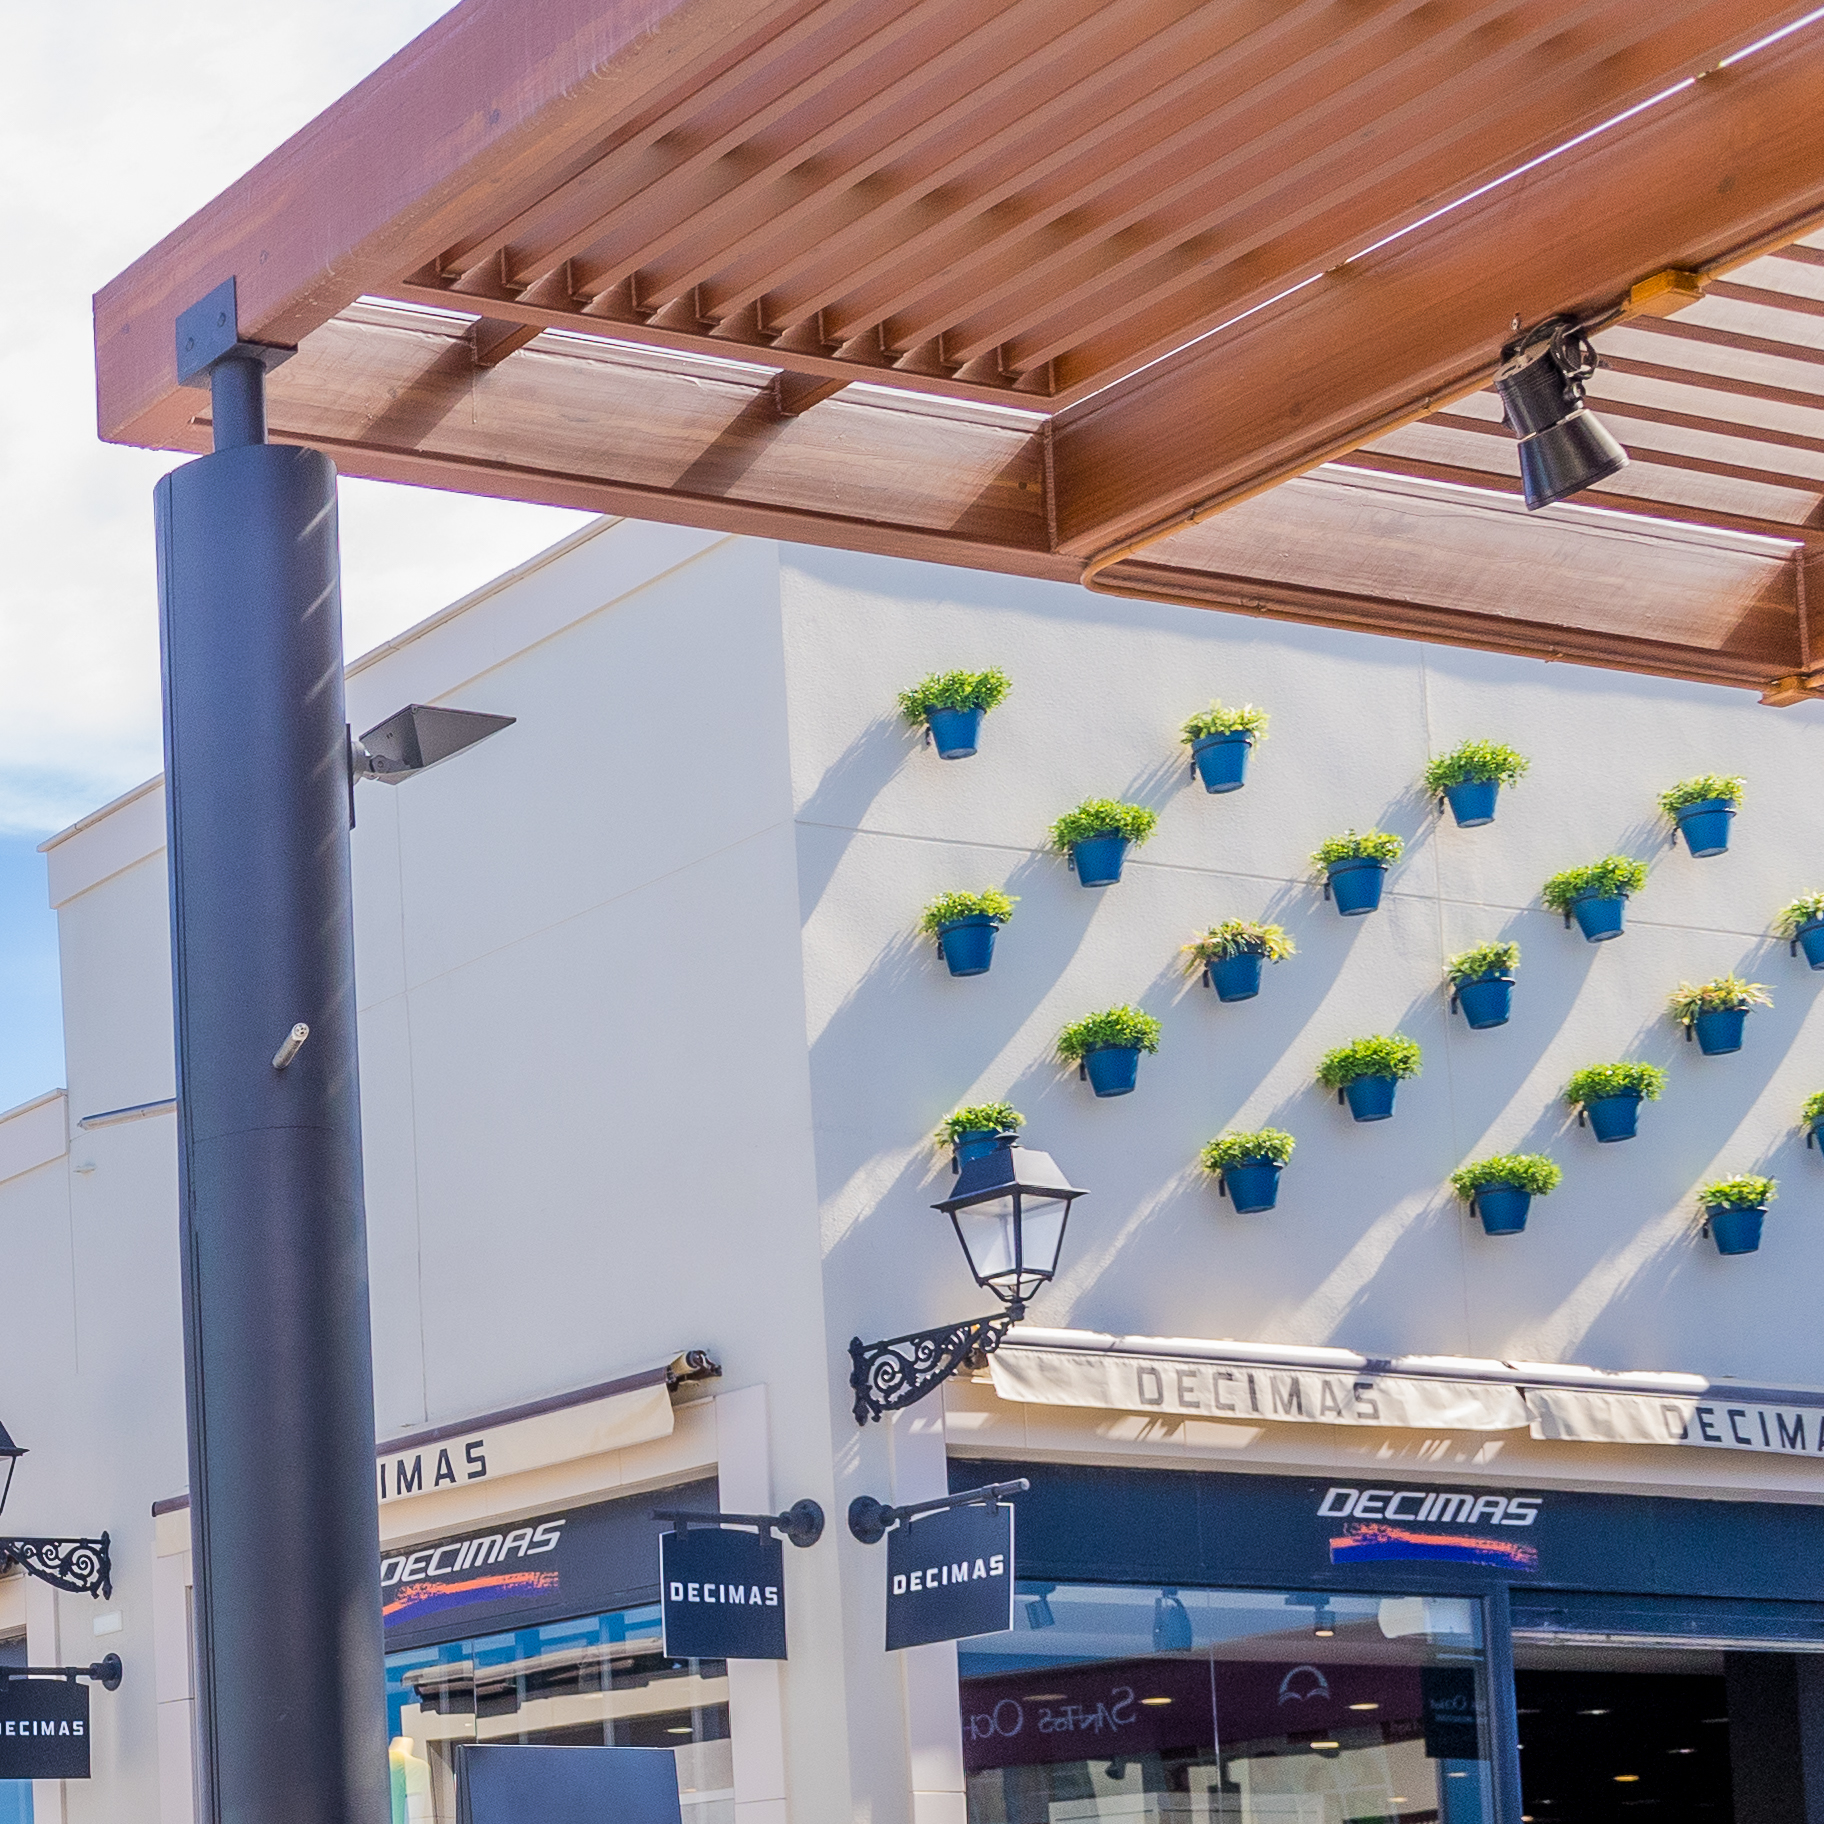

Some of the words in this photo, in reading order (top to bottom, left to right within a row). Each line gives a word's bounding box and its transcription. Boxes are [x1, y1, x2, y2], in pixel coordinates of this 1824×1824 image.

[1138, 1367, 1381, 1421] DECIMAS
[380, 1439, 487, 1500] IMAS
[1316, 1486, 1543, 1526] DECIMAS
[381, 1518, 566, 1587] DECIMAS
[893, 1554, 1005, 1595] DECIMAS
[670, 1582, 778, 1606] DECIMAS
